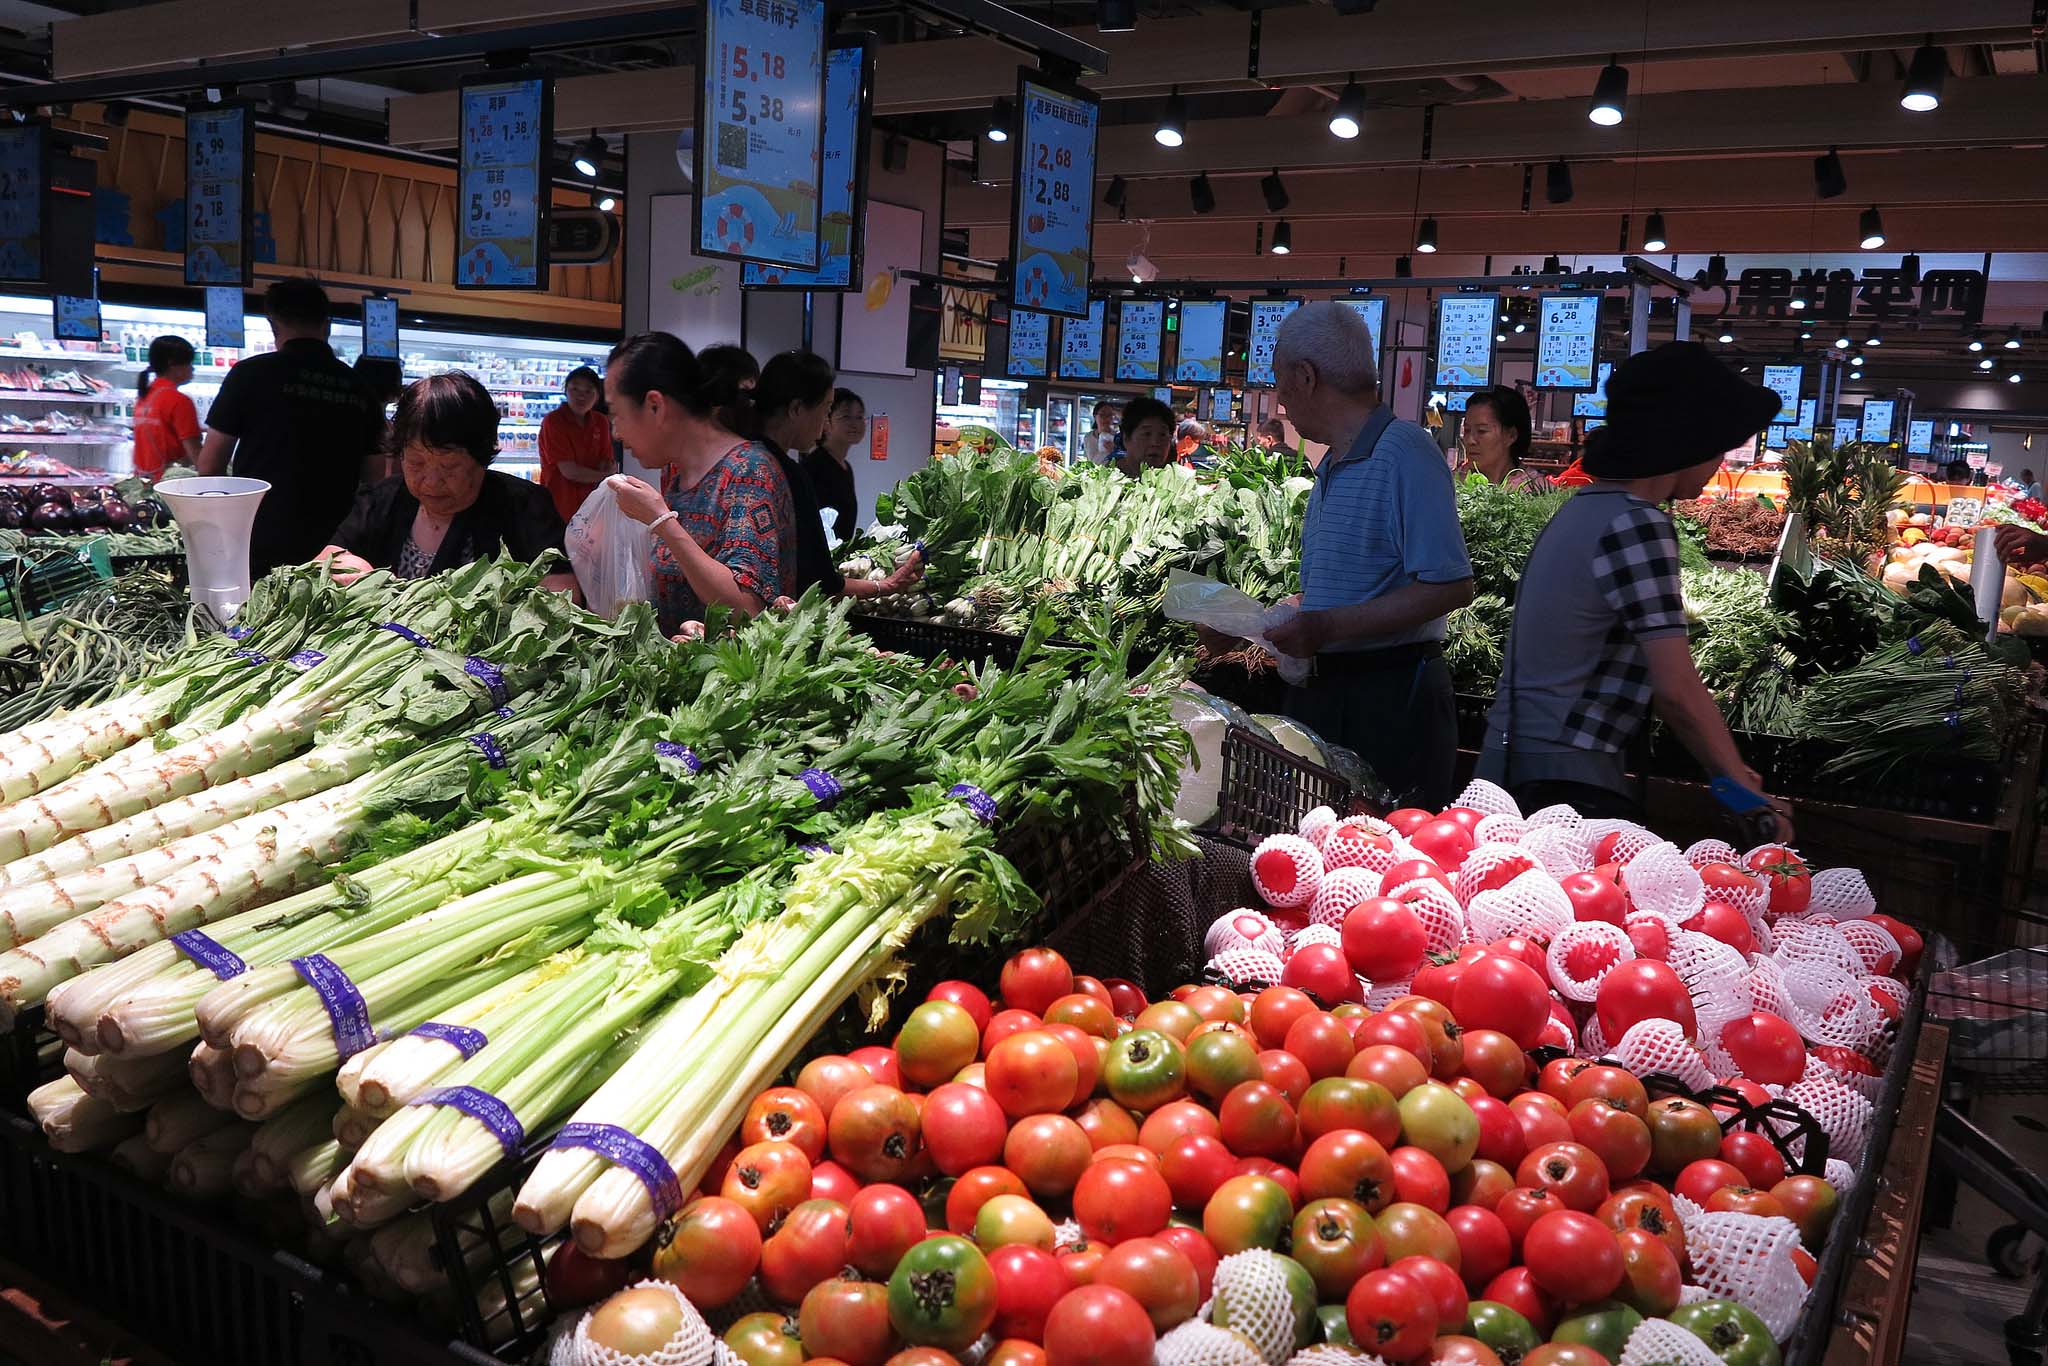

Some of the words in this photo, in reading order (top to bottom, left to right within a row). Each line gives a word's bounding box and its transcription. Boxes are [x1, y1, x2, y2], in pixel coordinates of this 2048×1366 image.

[732, 46, 785, 82] 5.18
[732, 89, 784, 125] 5.38
[1038, 143, 1072, 172] 2.68
[471, 189, 511, 221] 5.99
[1035, 179, 1070, 206] 2.88
[1257, 314, 1282, 328] 3.00
[1551, 311, 1577, 323] 6.28
[1067, 340, 1088, 352] 3.98
[1124, 342, 1146, 354] 6.98
[1256, 343, 1275, 357] 5.9
[333, 1003, 349, 1038] FRESH
